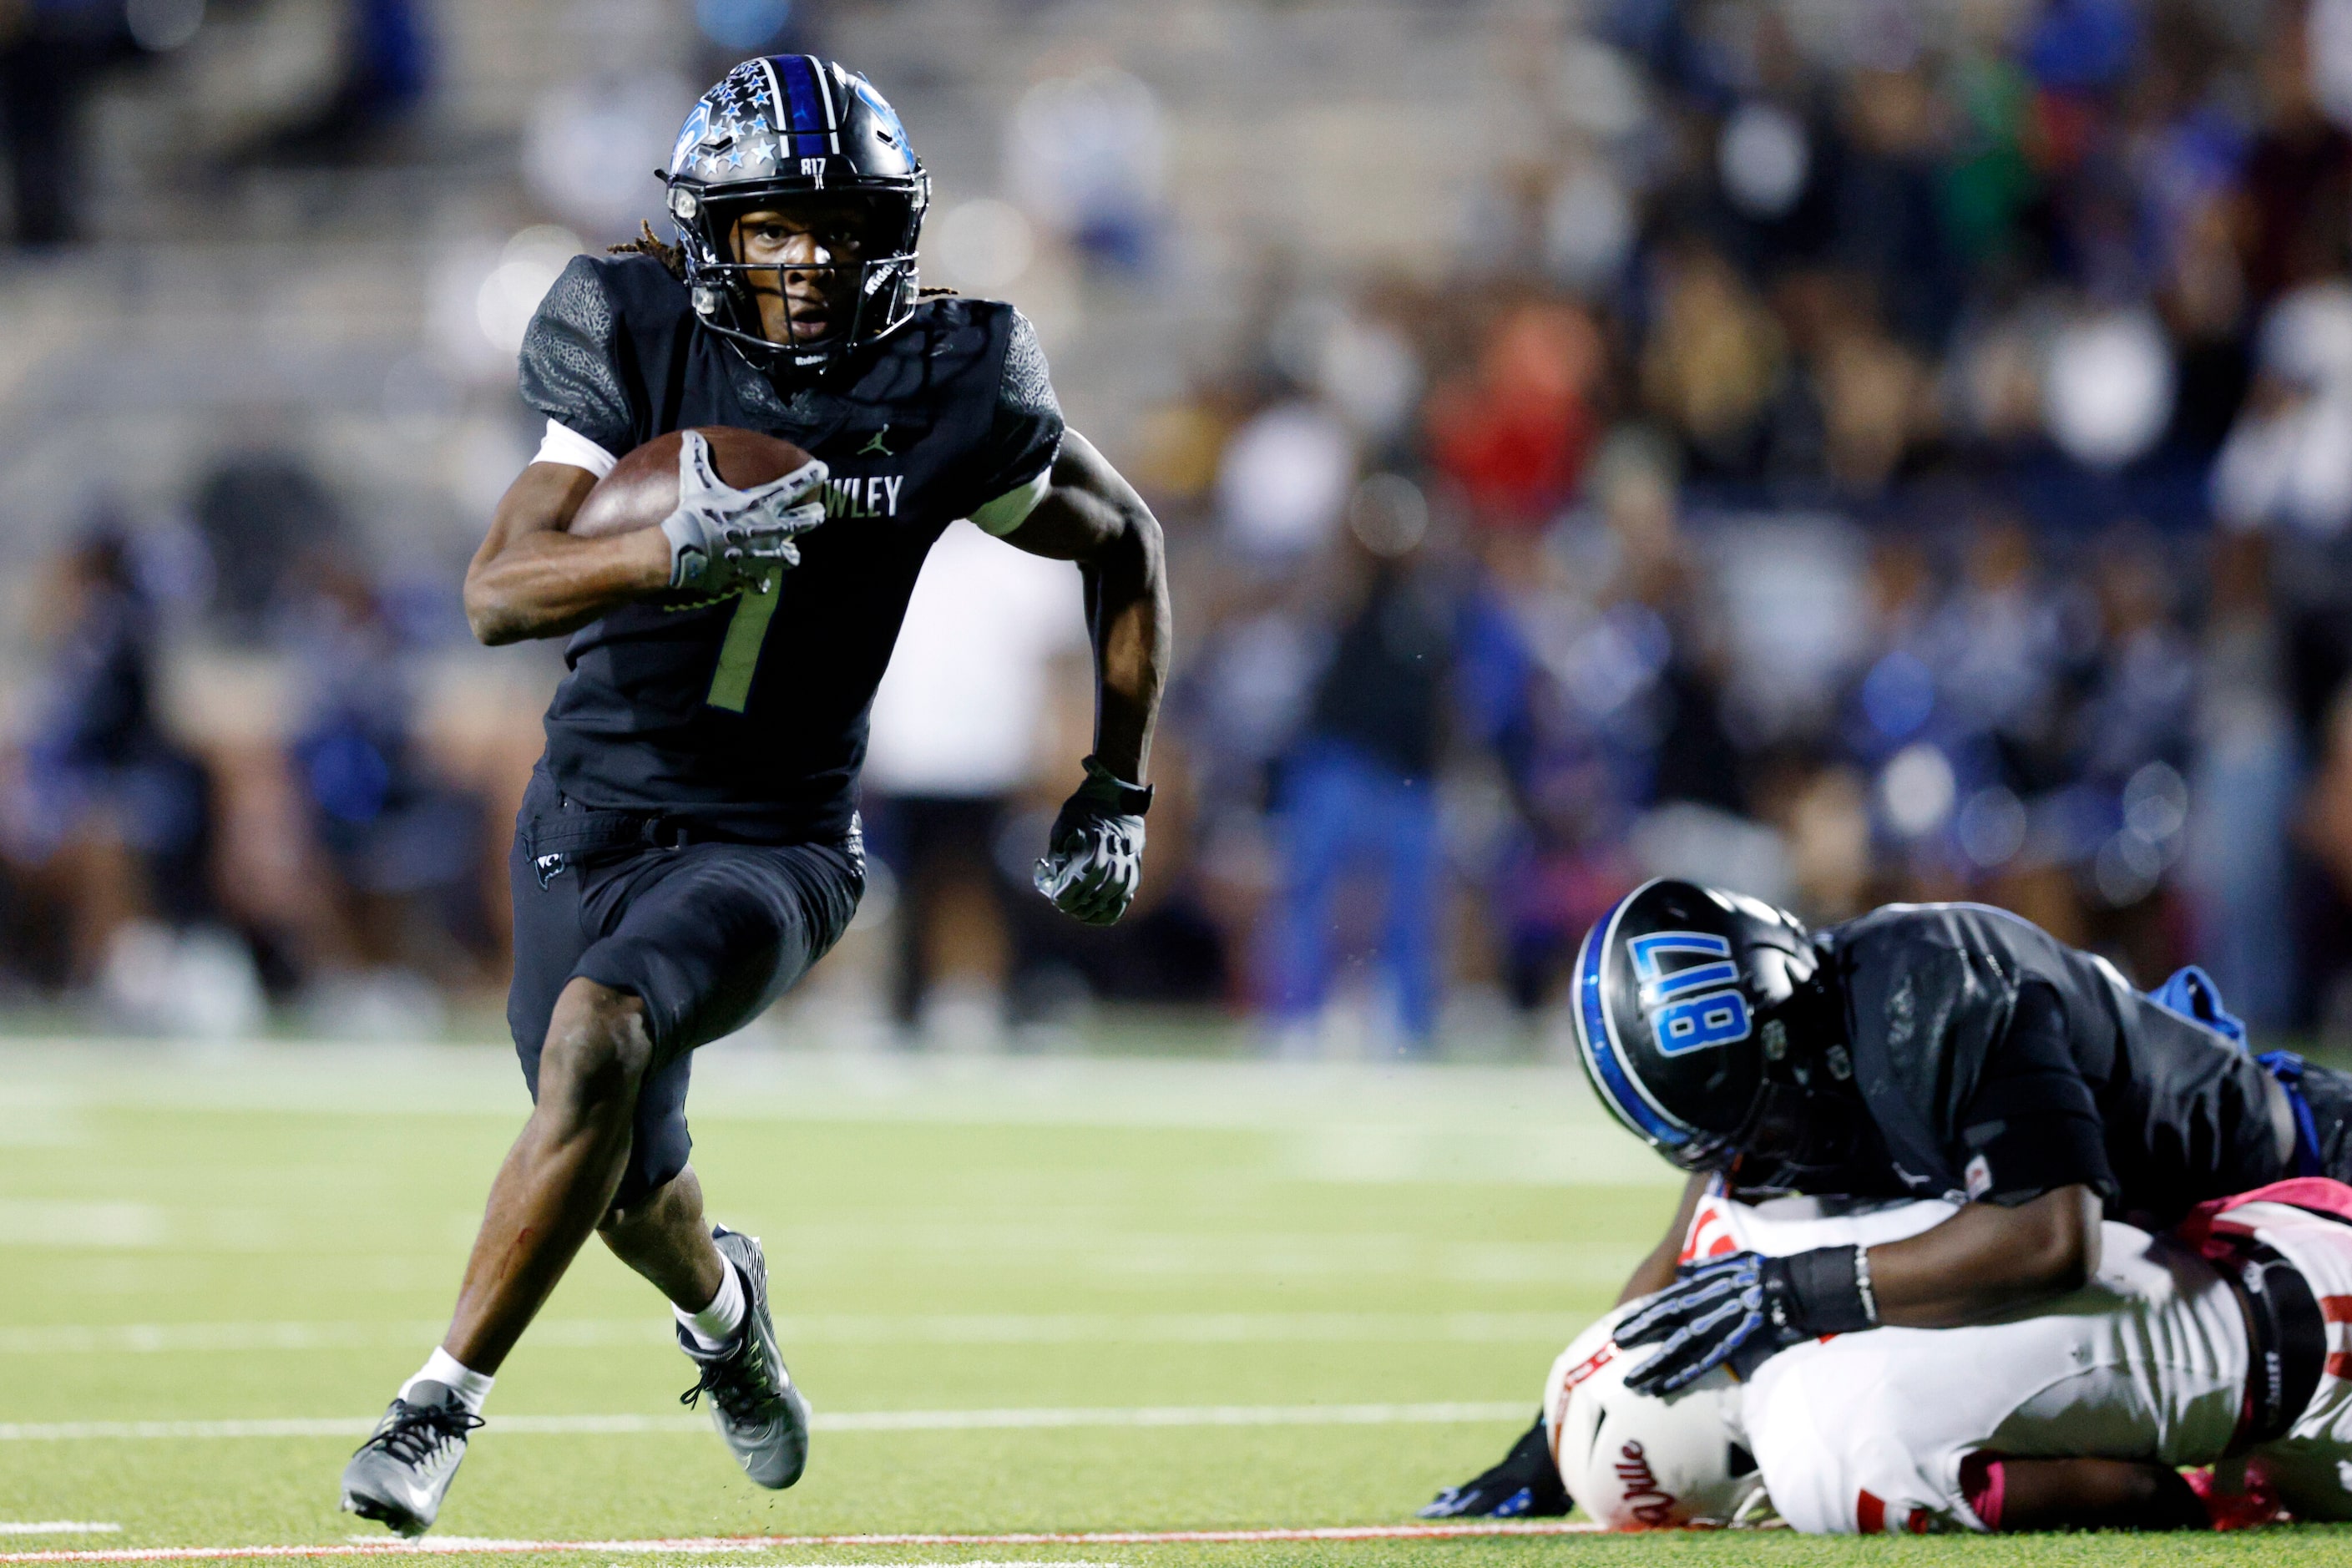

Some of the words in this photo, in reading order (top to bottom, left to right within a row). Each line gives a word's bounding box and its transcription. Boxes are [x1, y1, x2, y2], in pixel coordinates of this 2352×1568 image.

[800, 157, 827, 176] 817
[825, 475, 904, 518] WLEY
[1626, 930, 1753, 1059] 817
